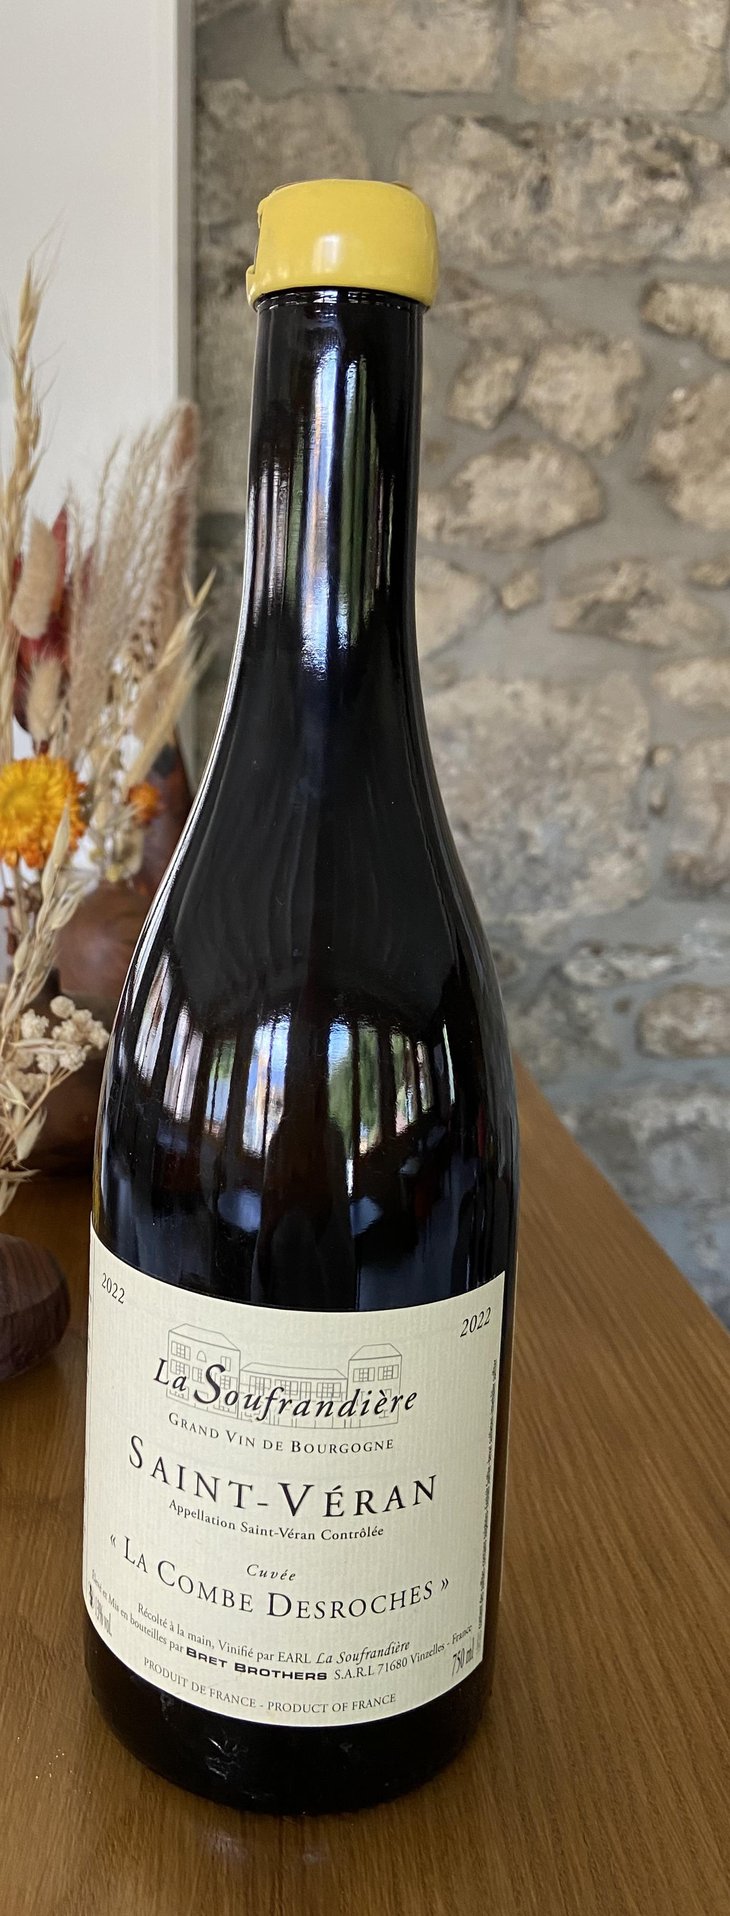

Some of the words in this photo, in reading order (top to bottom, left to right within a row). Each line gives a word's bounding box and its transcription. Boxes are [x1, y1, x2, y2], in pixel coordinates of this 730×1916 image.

[101, 1272, 126, 1304] 2022
[460, 1307, 491, 1337] 2022
[153, 1357, 187, 1392] La
[193, 1363, 417, 1422] Soufrandière
[168, 1412, 219, 1439] GRAND
[225, 1429, 255, 1447] VIN
[263, 1439, 283, 1451] DE
[291, 1439, 394, 1454] BOURGOGNE
[129, 1435, 437, 1518] SAINT-VÉRAN
[169, 1499, 236, 1530] Appellation
[240, 1521, 315, 1540] Saint-Véran
[321, 1526, 384, 1541] Contrôlée
[124, 1536, 148, 1573] LA
[157, 1560, 254, 1613] COMBE
[266, 1580, 433, 1620] DESROCHES
[246, 1563, 296, 1581] Cuvée
[108, 1593, 120, 1611] Mis
[121, 1609, 129, 1621] en
[130, 1613, 167, 1645] bouteilles
[169, 1640, 184, 1653] par
[186, 1646, 228, 1669] BRET
[234, 1662, 327, 1681] BROTHERS
[377, 1657, 408, 1675] 71680
[410, 1643, 445, 1664] Vinzelles
[452, 1625, 472, 1644] France
[137, 1602, 167, 1628] Récolté
[169, 1620, 175, 1632] à
[177, 1623, 185, 1637] la
[188, 1633, 215, 1649] main,
[218, 1639, 254, 1658] Vinifié
[256, 1651, 274, 1663] par
[278, 1651, 311, 1664] EARL
[315, 1652, 333, 1664] La
[336, 1640, 411, 1665] Soufrandière
[144, 1657, 188, 1687] PRODUIT
[191, 1680, 206, 1695] DE
[209, 1688, 257, 1708] FRANCE
[267, 1701, 328, 1713] PRODUCT
[332, 1702, 348, 1713] OF
[352, 1693, 397, 1711] FRANCE
[452, 1648, 465, 1677] 750
